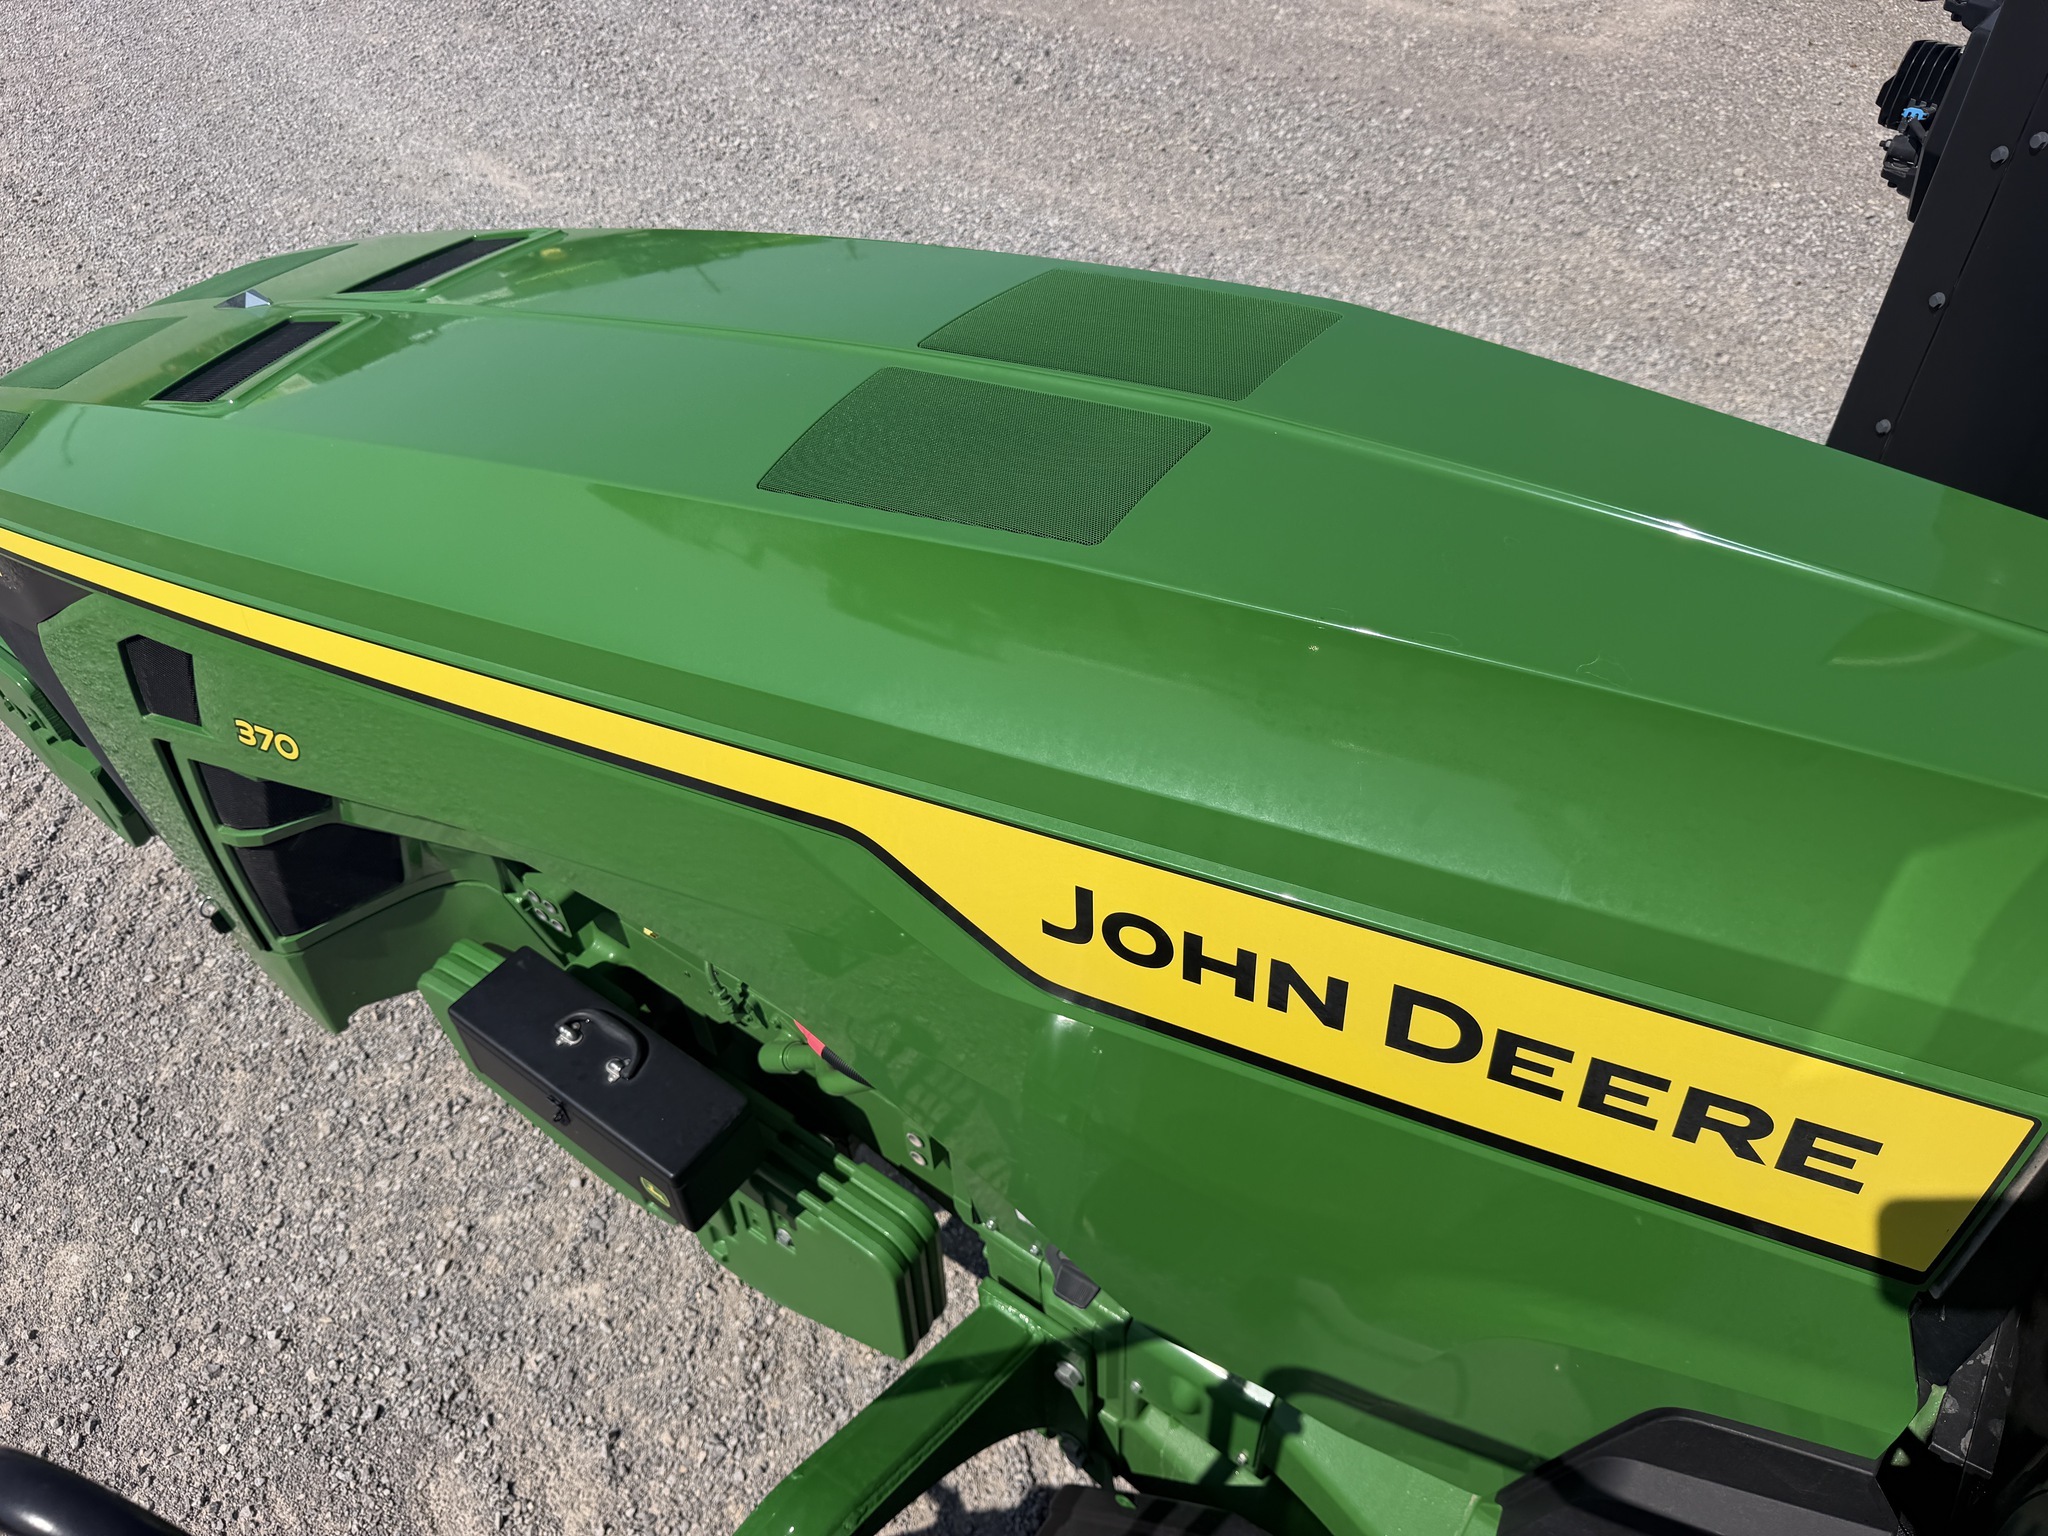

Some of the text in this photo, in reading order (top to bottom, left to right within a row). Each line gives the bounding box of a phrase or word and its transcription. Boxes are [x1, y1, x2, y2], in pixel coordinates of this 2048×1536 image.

[234, 719, 300, 761] 370
[1042, 886, 1883, 1195] JOHN DEERE
